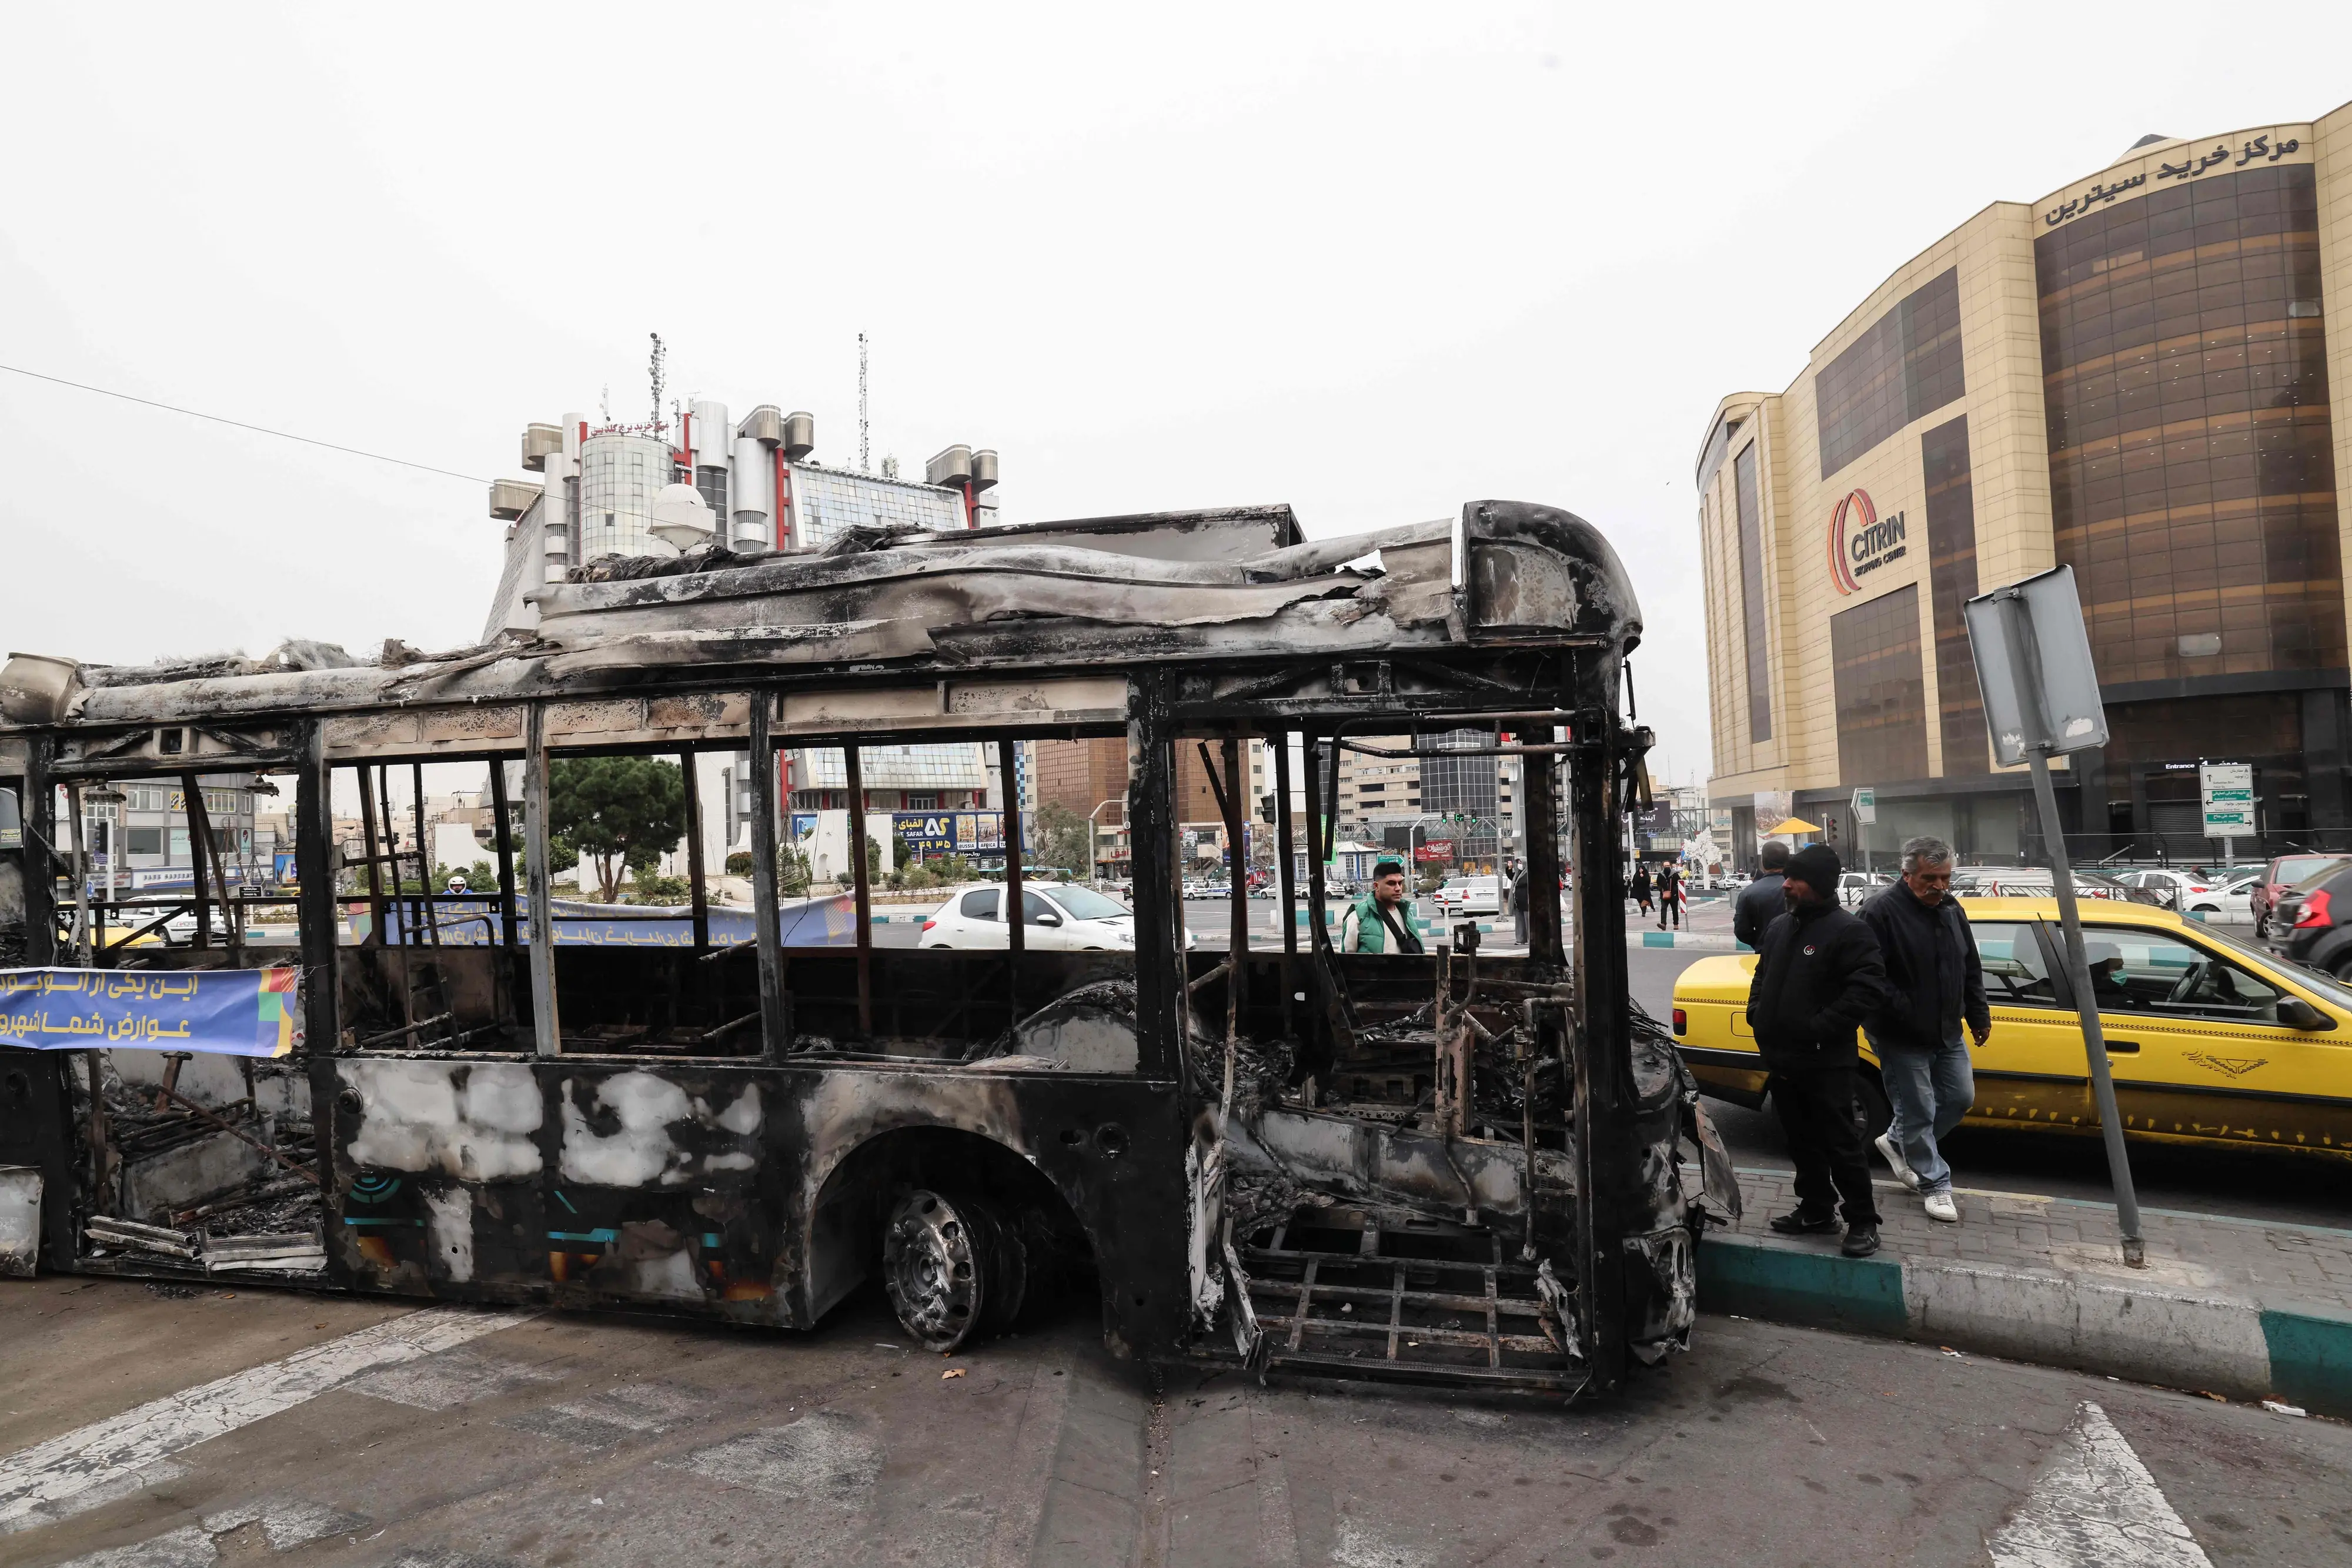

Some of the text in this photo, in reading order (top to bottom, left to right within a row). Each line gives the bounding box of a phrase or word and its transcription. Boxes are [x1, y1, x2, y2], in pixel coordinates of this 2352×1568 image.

[2046, 135, 2299, 226] مرکز خرید سیترین
[591, 423, 617, 436] گلدیس
[619, 424, 632, 434] برج
[634, 422, 653, 432] خرید
[1851, 511, 1905, 561] CITRIN
[1855, 546, 1906, 577] SHOPPING CENTER
[898, 818, 923, 830] الفبای
[108, 972, 146, 1000] یکی
[151, 974, 198, 1001] این
[0, 1009, 191, 1042] عوارض شما شهرو
